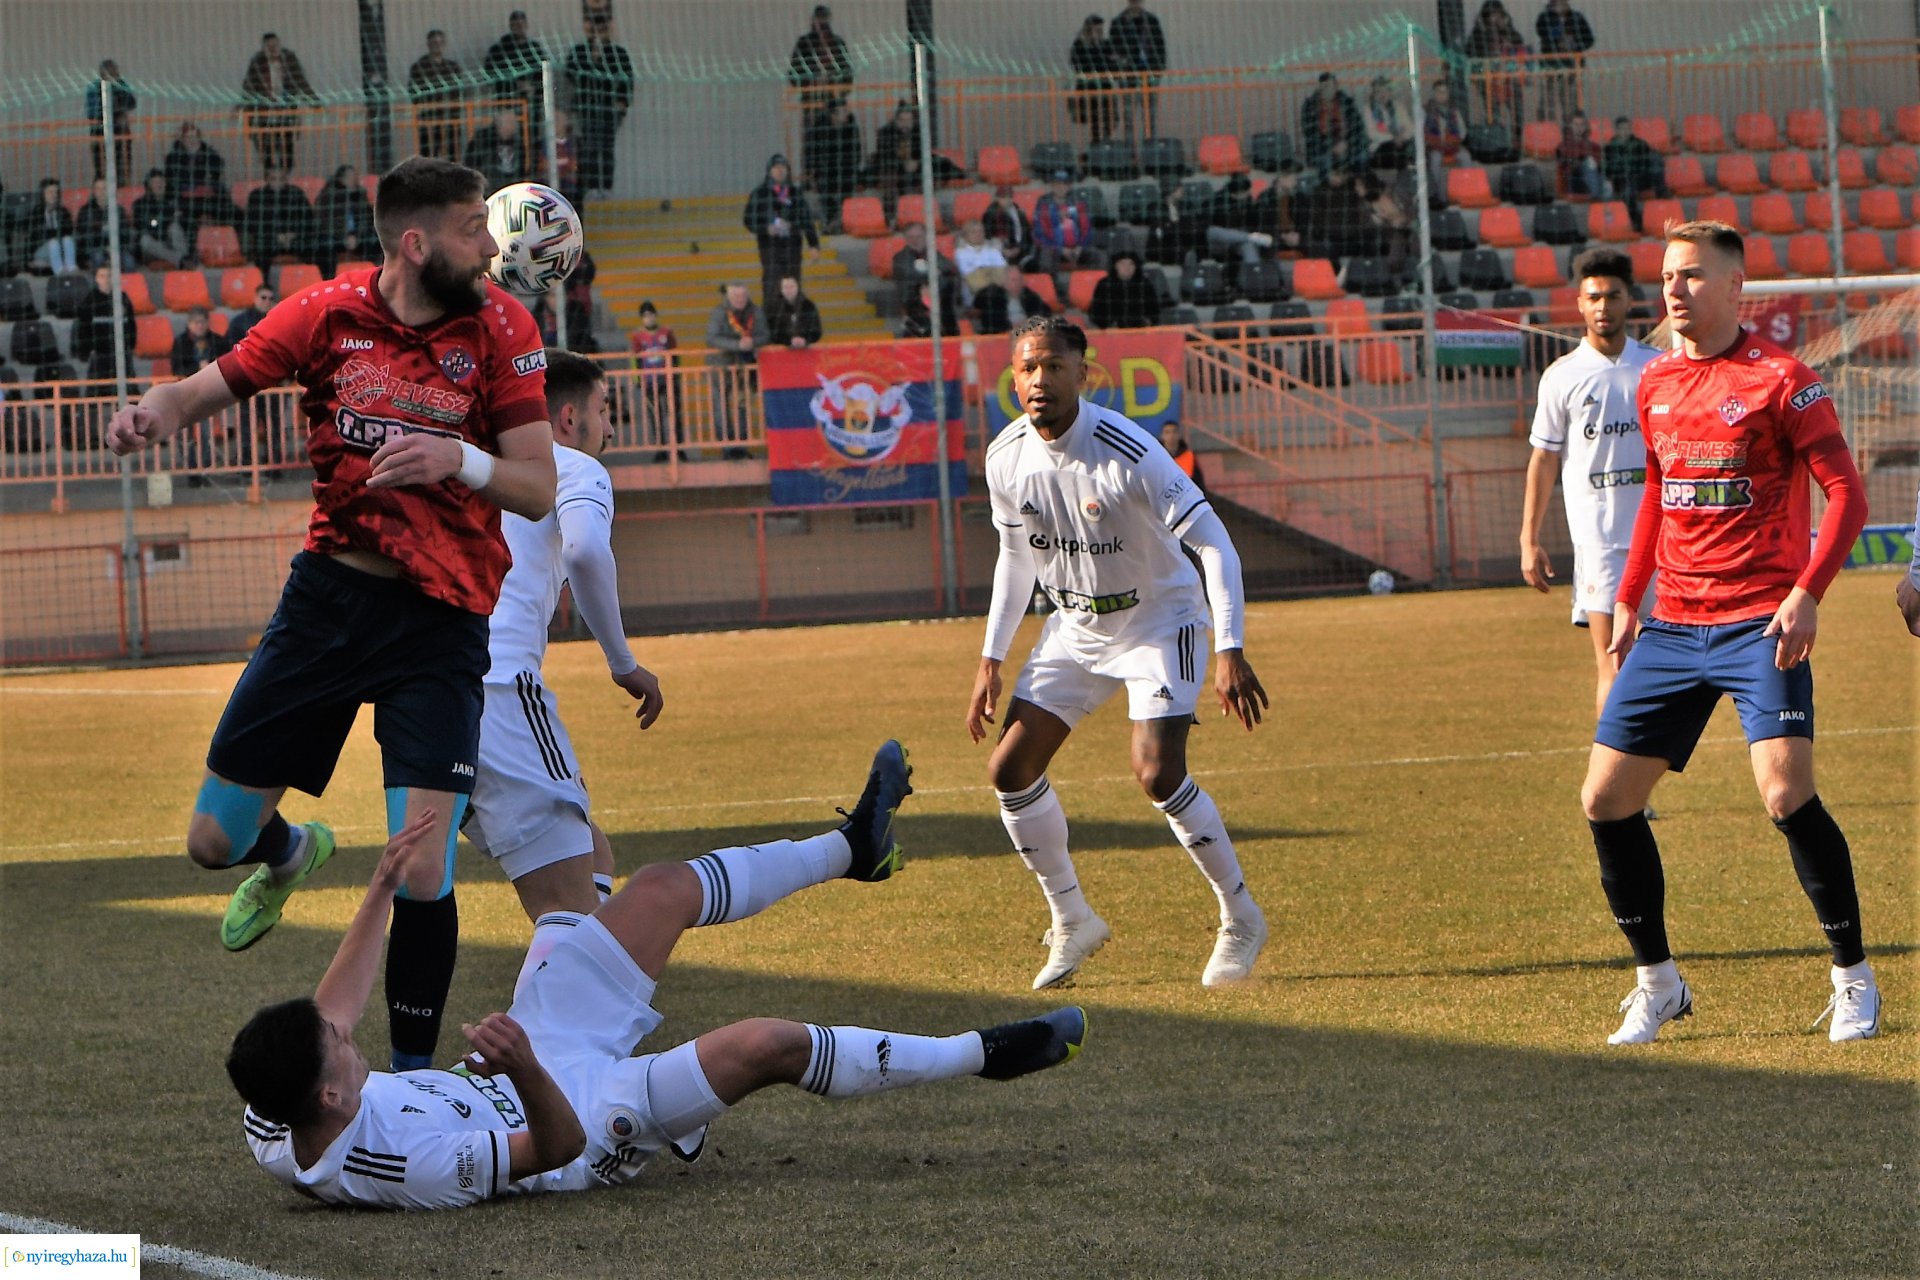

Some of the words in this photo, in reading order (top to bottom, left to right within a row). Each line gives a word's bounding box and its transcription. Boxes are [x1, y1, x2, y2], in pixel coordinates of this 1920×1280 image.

[340, 337, 374, 350] JAKO
[1603, 418, 1641, 437] otpb
[1778, 710, 1806, 722] JAKO
[451, 762, 476, 778] JAKO
[393, 1001, 433, 1017] JAKO
